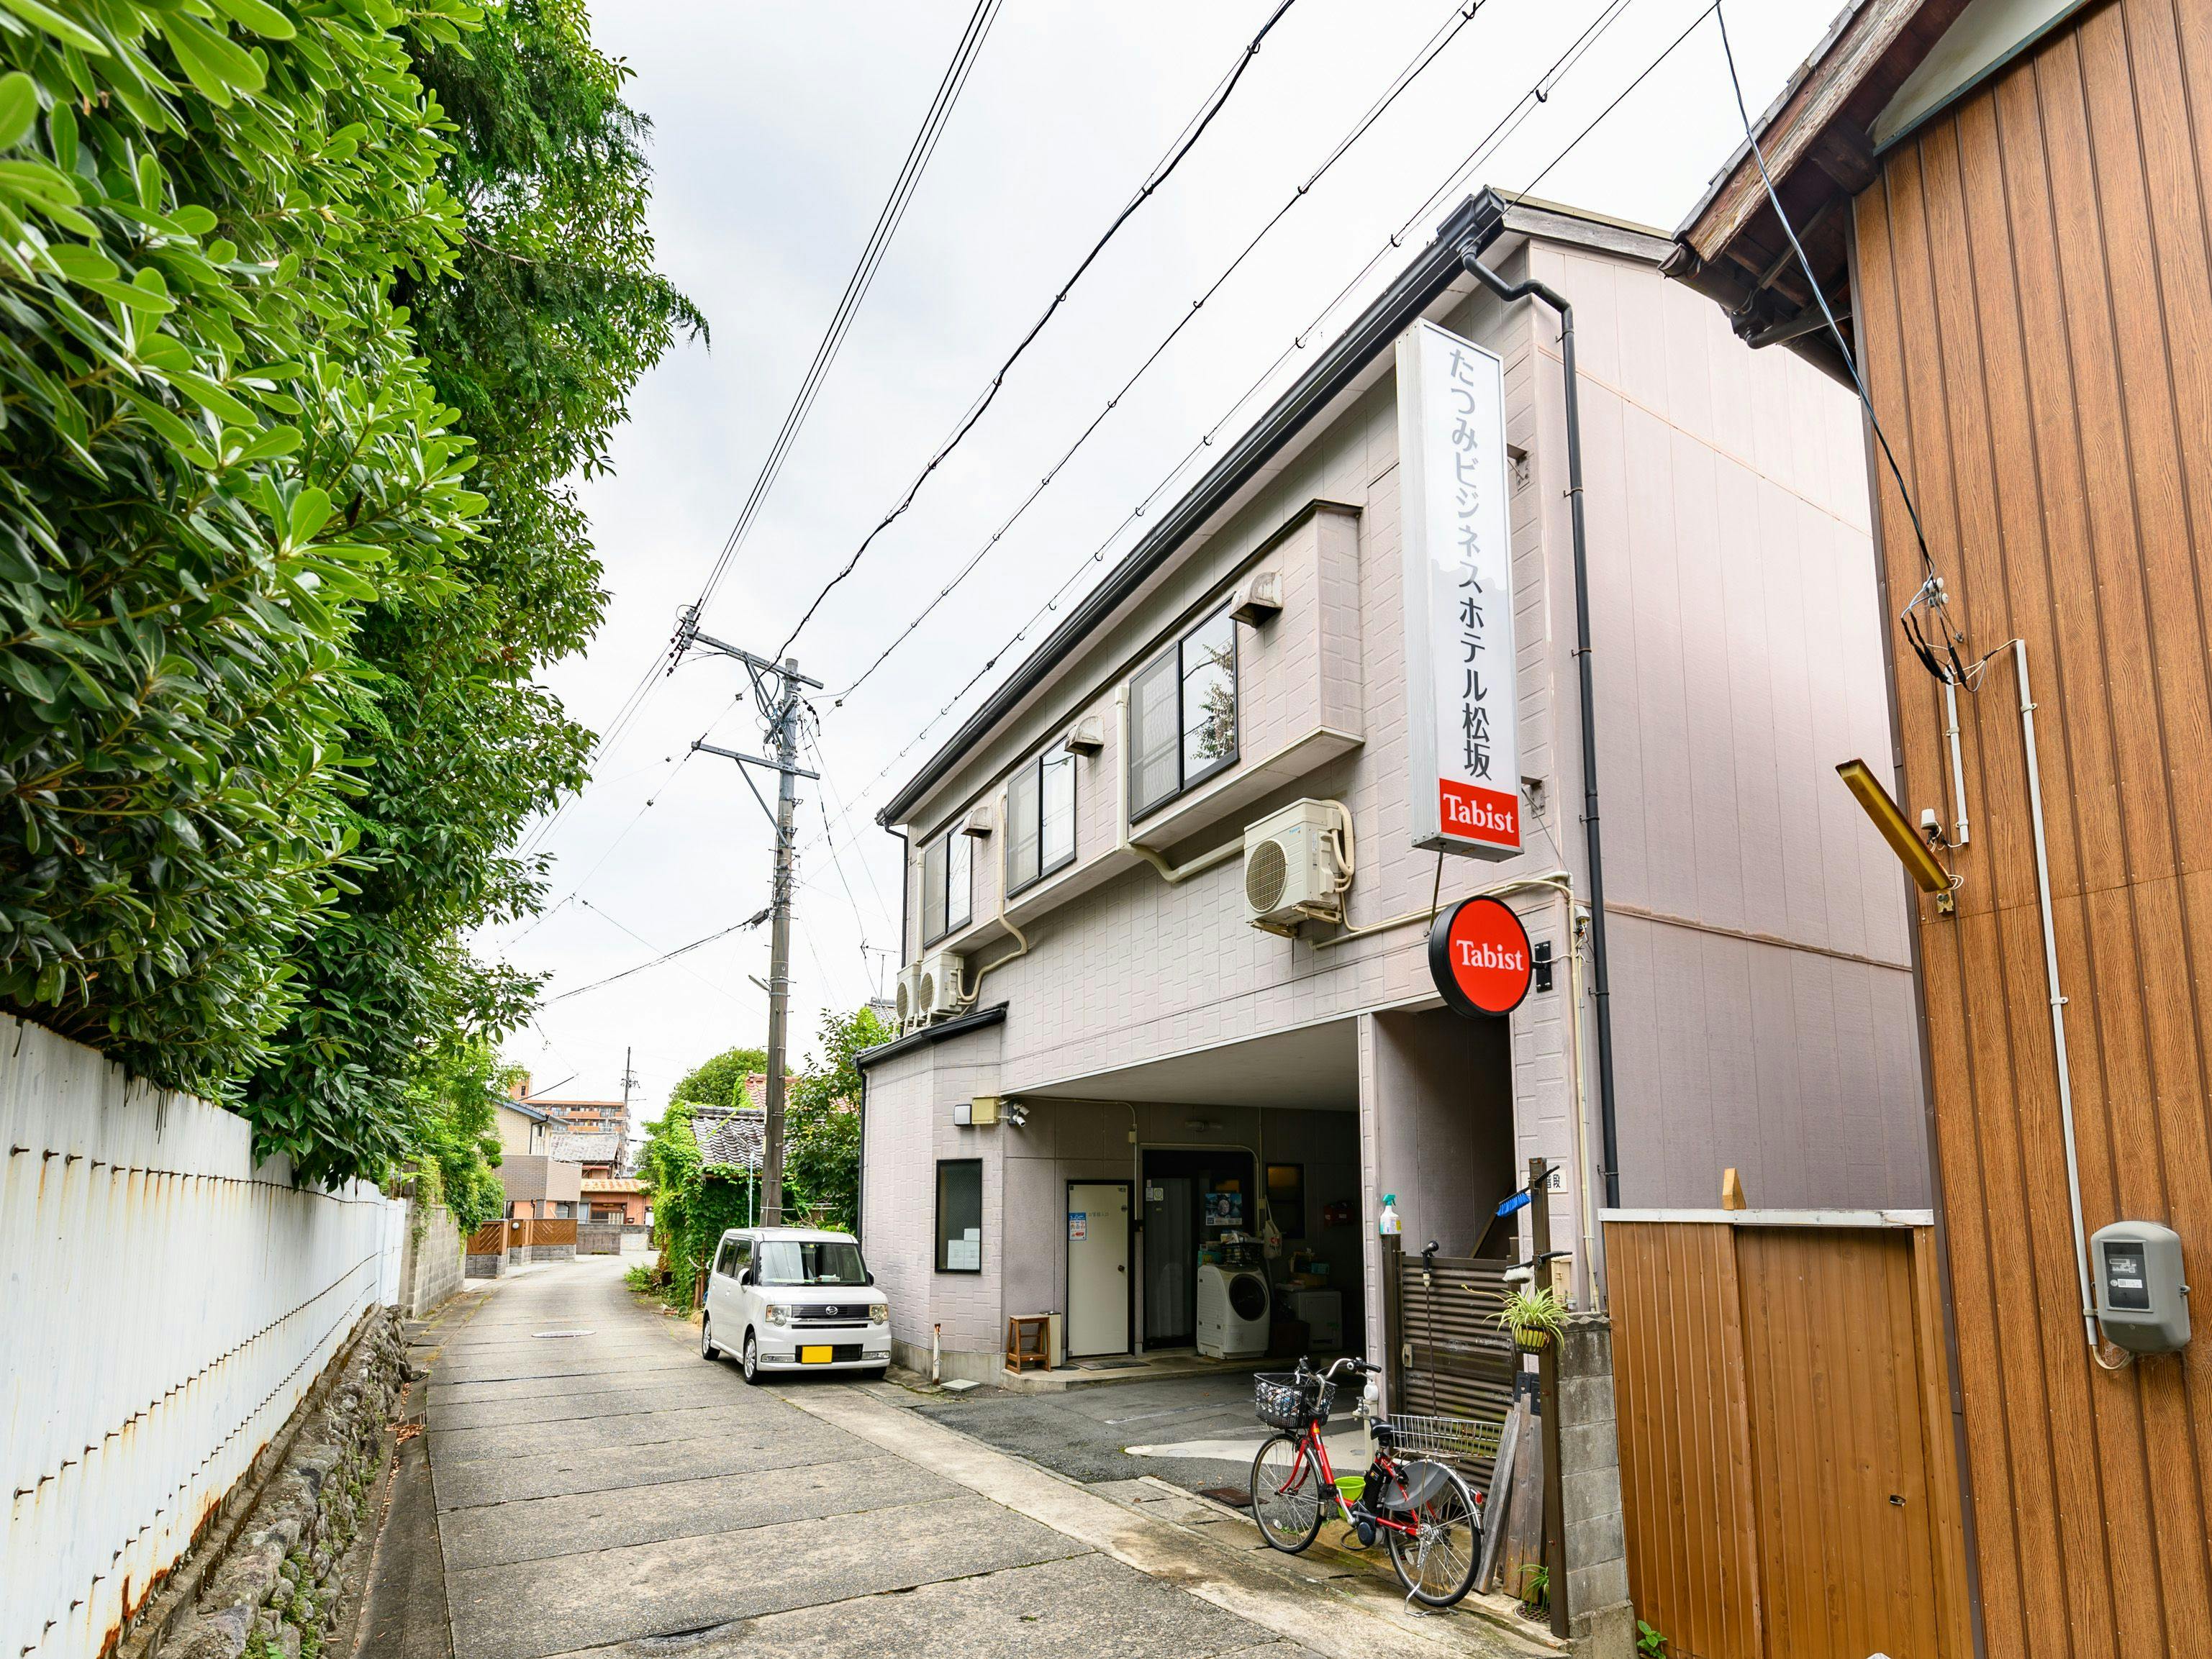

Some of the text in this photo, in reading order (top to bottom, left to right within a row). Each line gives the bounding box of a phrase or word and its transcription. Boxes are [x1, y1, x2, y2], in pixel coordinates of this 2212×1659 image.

[1449, 348, 1492, 781] たつみビジネスホテル松坂
[1443, 793, 1515, 834] Tabist
[1456, 939, 1525, 971] Tabist
